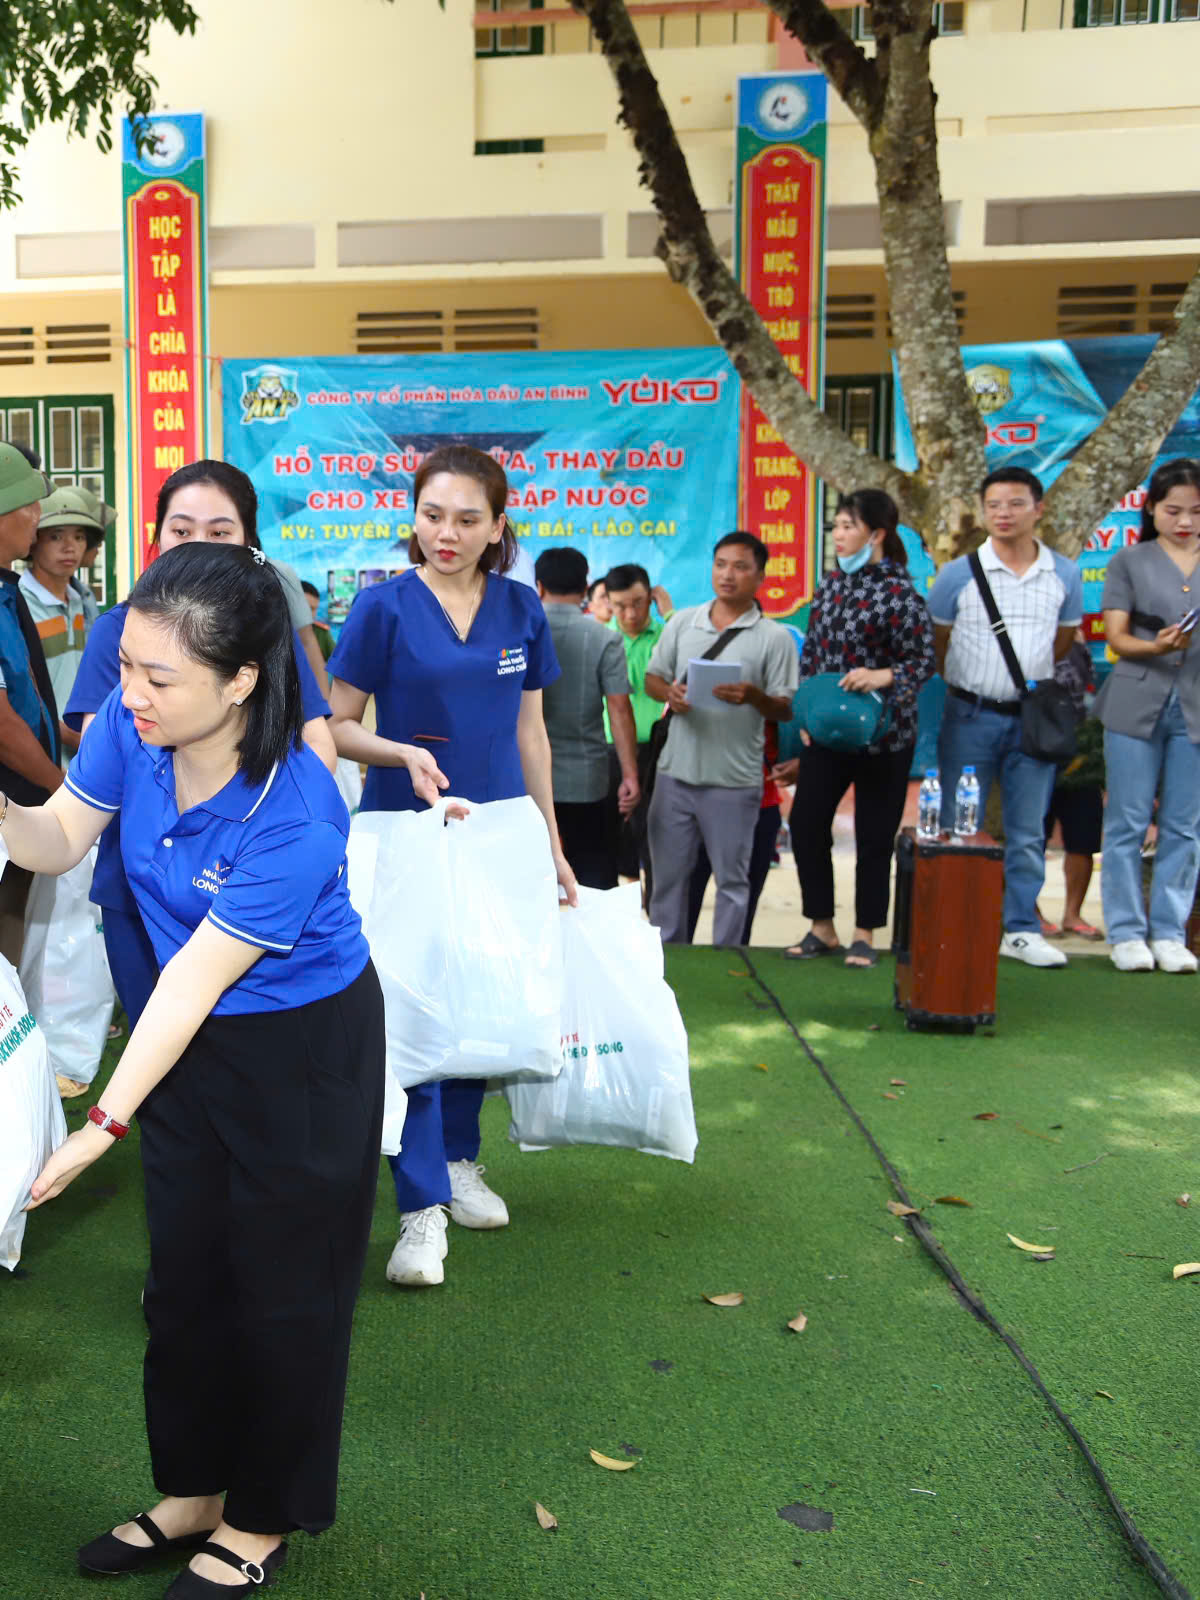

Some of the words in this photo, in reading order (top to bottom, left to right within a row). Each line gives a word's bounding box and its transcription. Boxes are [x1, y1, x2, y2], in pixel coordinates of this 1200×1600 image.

[148, 215, 182, 244] HỌC
[151, 249, 181, 284] TẬP
[156, 288, 177, 317] LÀ
[148, 328, 186, 354] CHÌA
[147, 365, 189, 393] KHÓA
[307, 389, 351, 405] CÔNG
[354, 391, 374, 403] TY
[524, 388, 545, 400] AN
[153, 401, 185, 432] CỦA
[154, 445, 185, 473] MỌI
[320, 454, 377, 478] TRỢ
[545, 450, 619, 470] THAY
[308, 491, 365, 510] CHO
[373, 490, 409, 510] XE
[566, 480, 650, 507] NƯỚC
[639, 519, 677, 537] CAI
